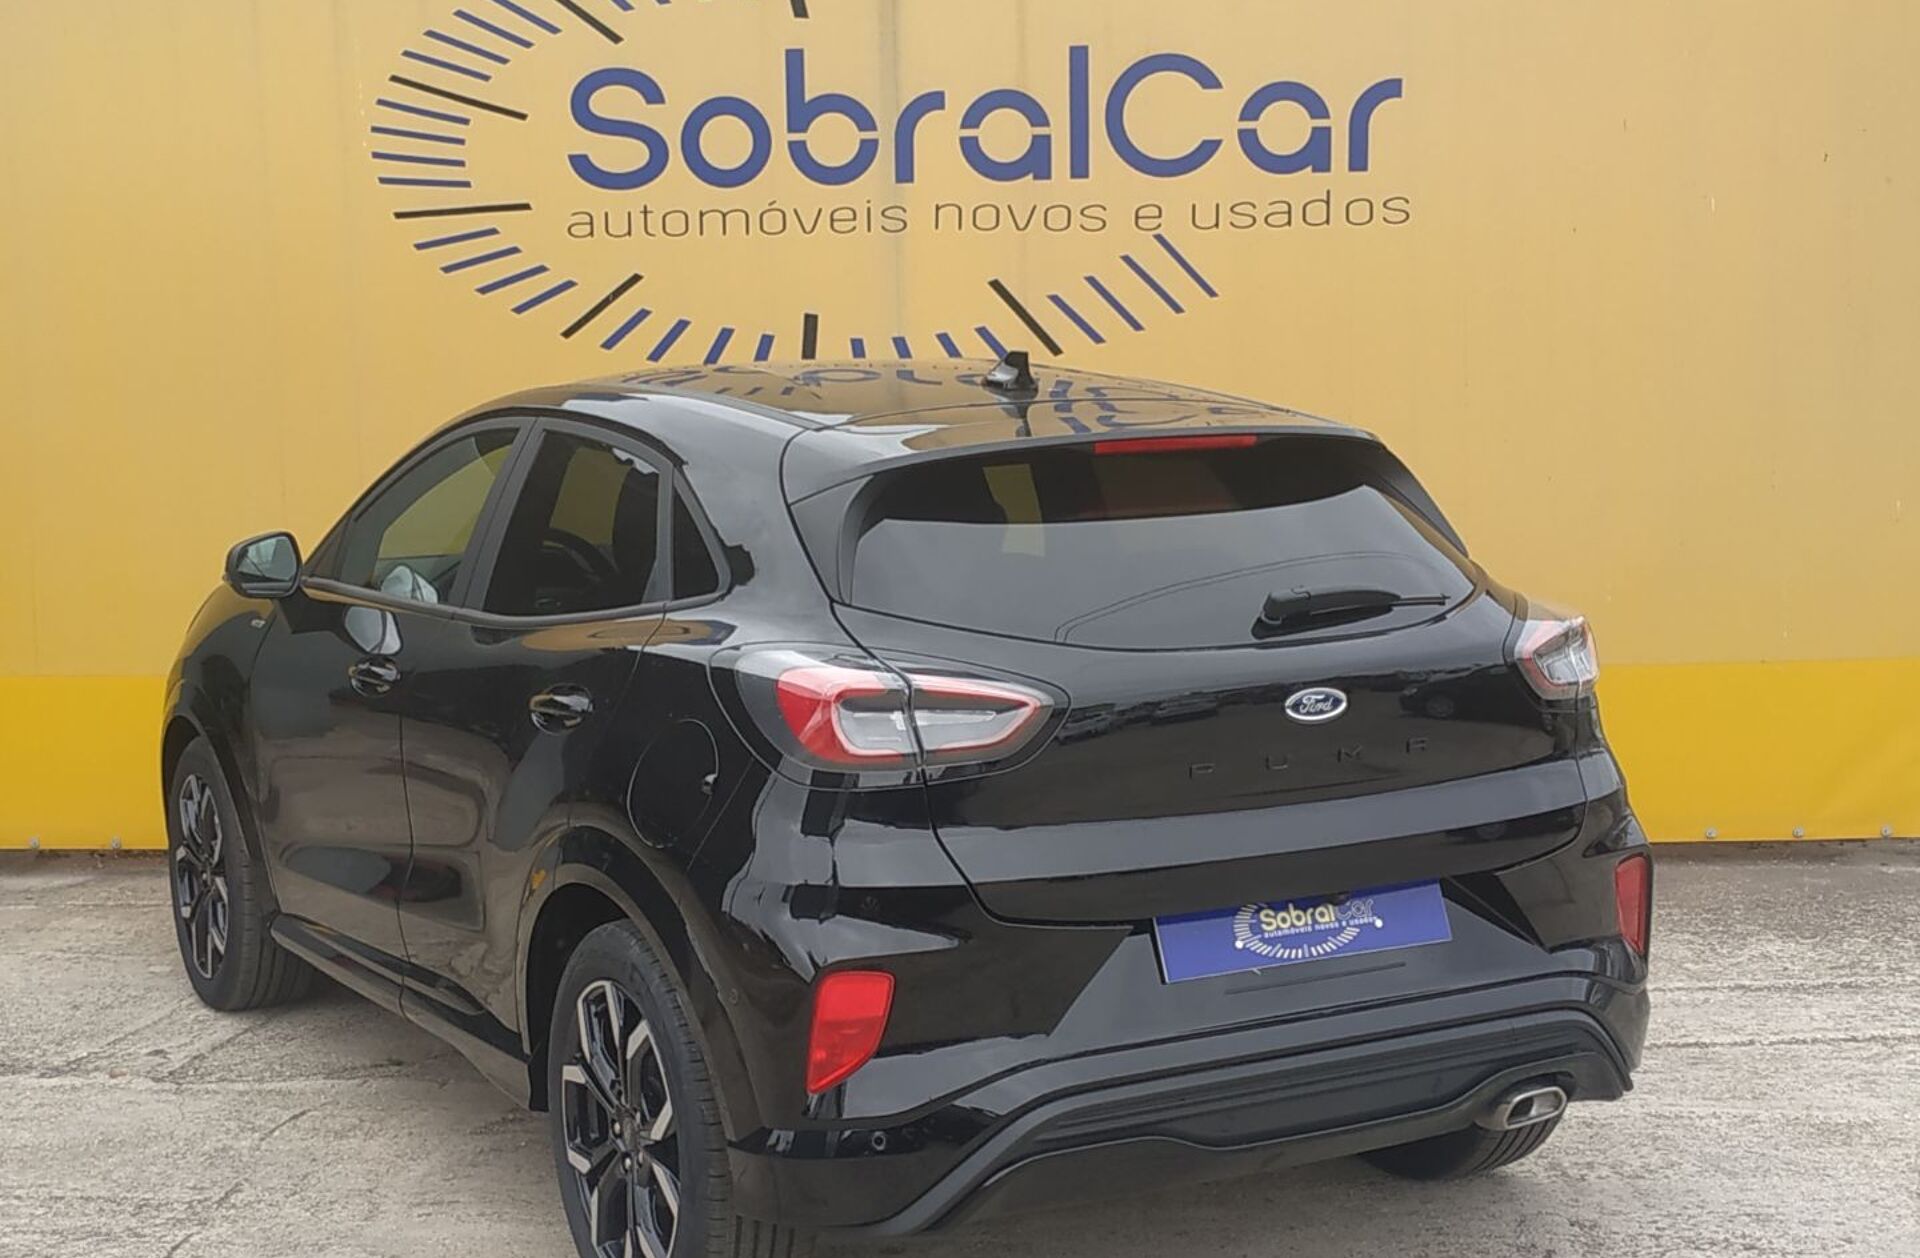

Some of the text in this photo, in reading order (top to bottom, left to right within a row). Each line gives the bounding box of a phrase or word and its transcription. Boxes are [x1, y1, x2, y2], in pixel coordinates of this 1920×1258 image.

[566, 44, 1404, 190] SobralCar
[566, 188, 1412, 239] automóveis novos e usados
[1299, 694, 1335, 714] Ford
